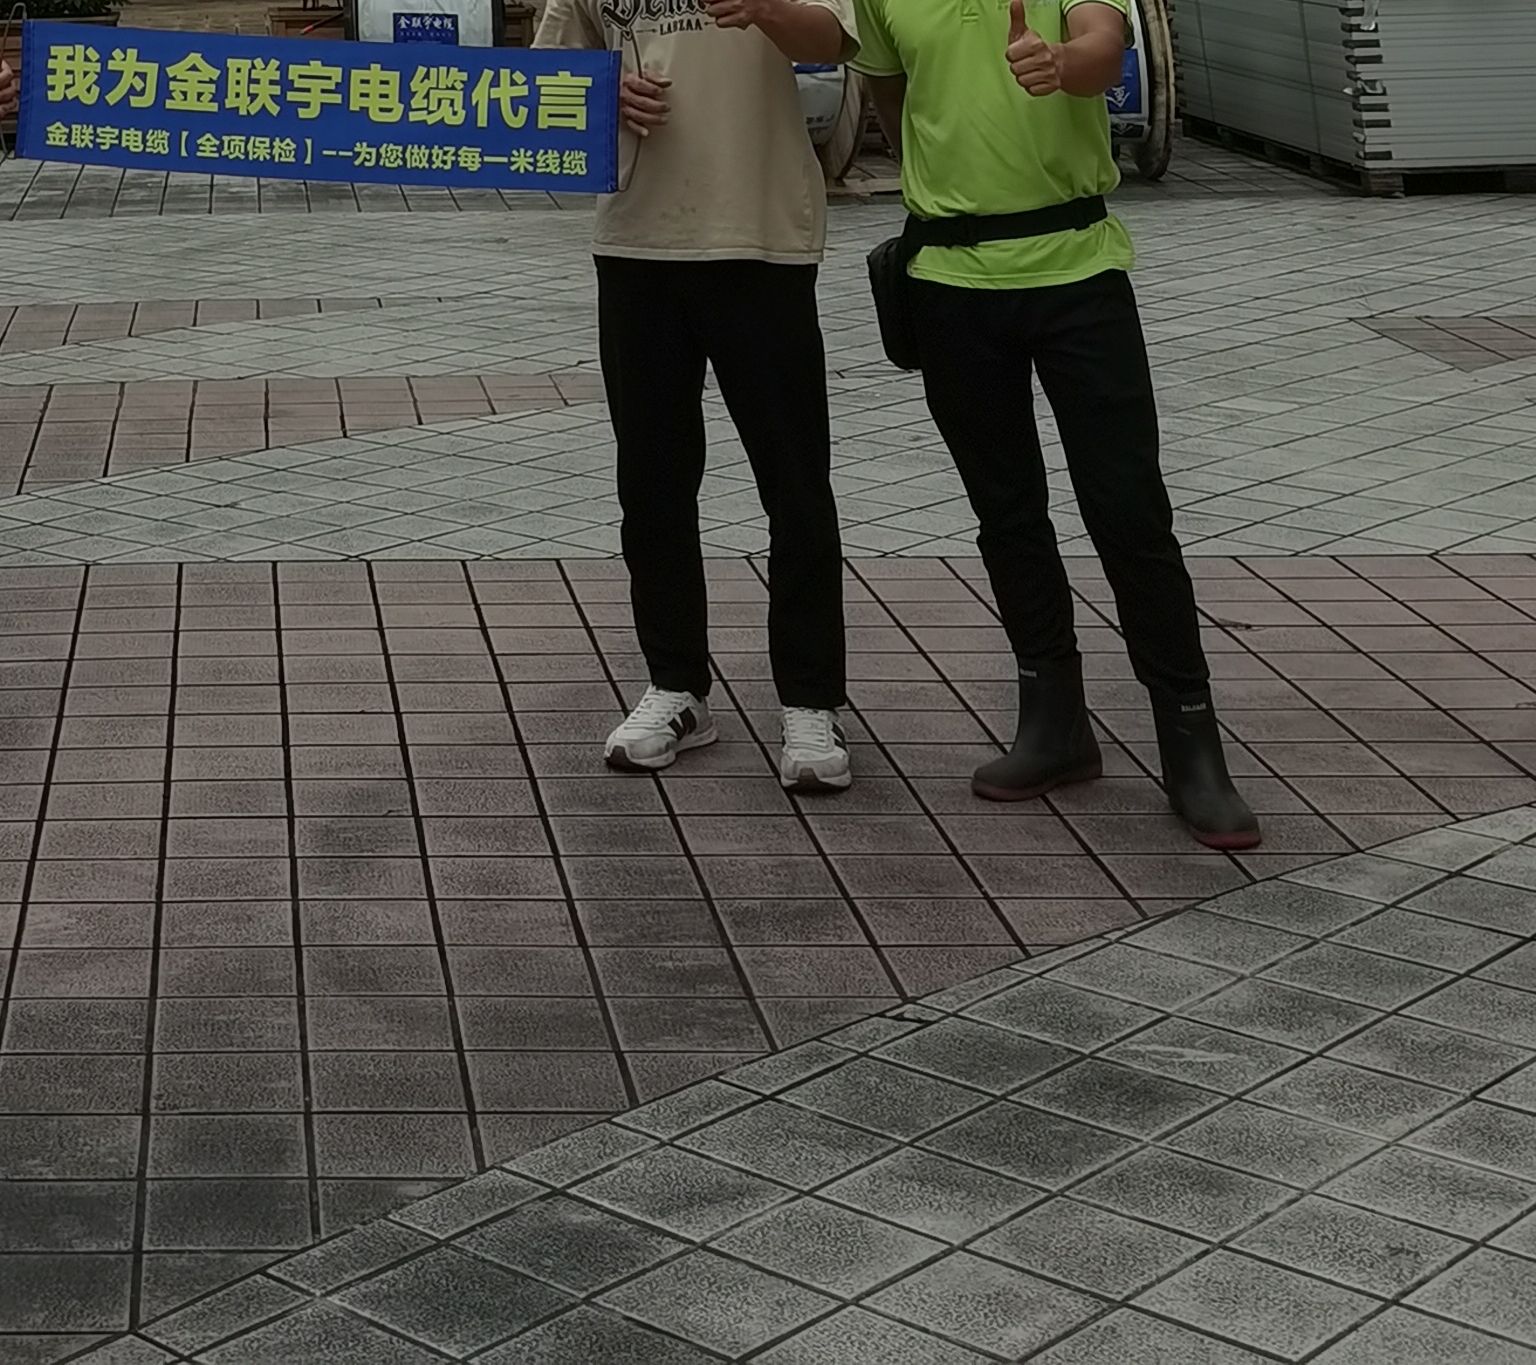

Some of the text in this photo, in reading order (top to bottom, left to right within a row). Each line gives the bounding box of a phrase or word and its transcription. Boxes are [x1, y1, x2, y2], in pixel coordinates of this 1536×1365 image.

[46, 44, 593, 132] 我为金联宇电缆代言
